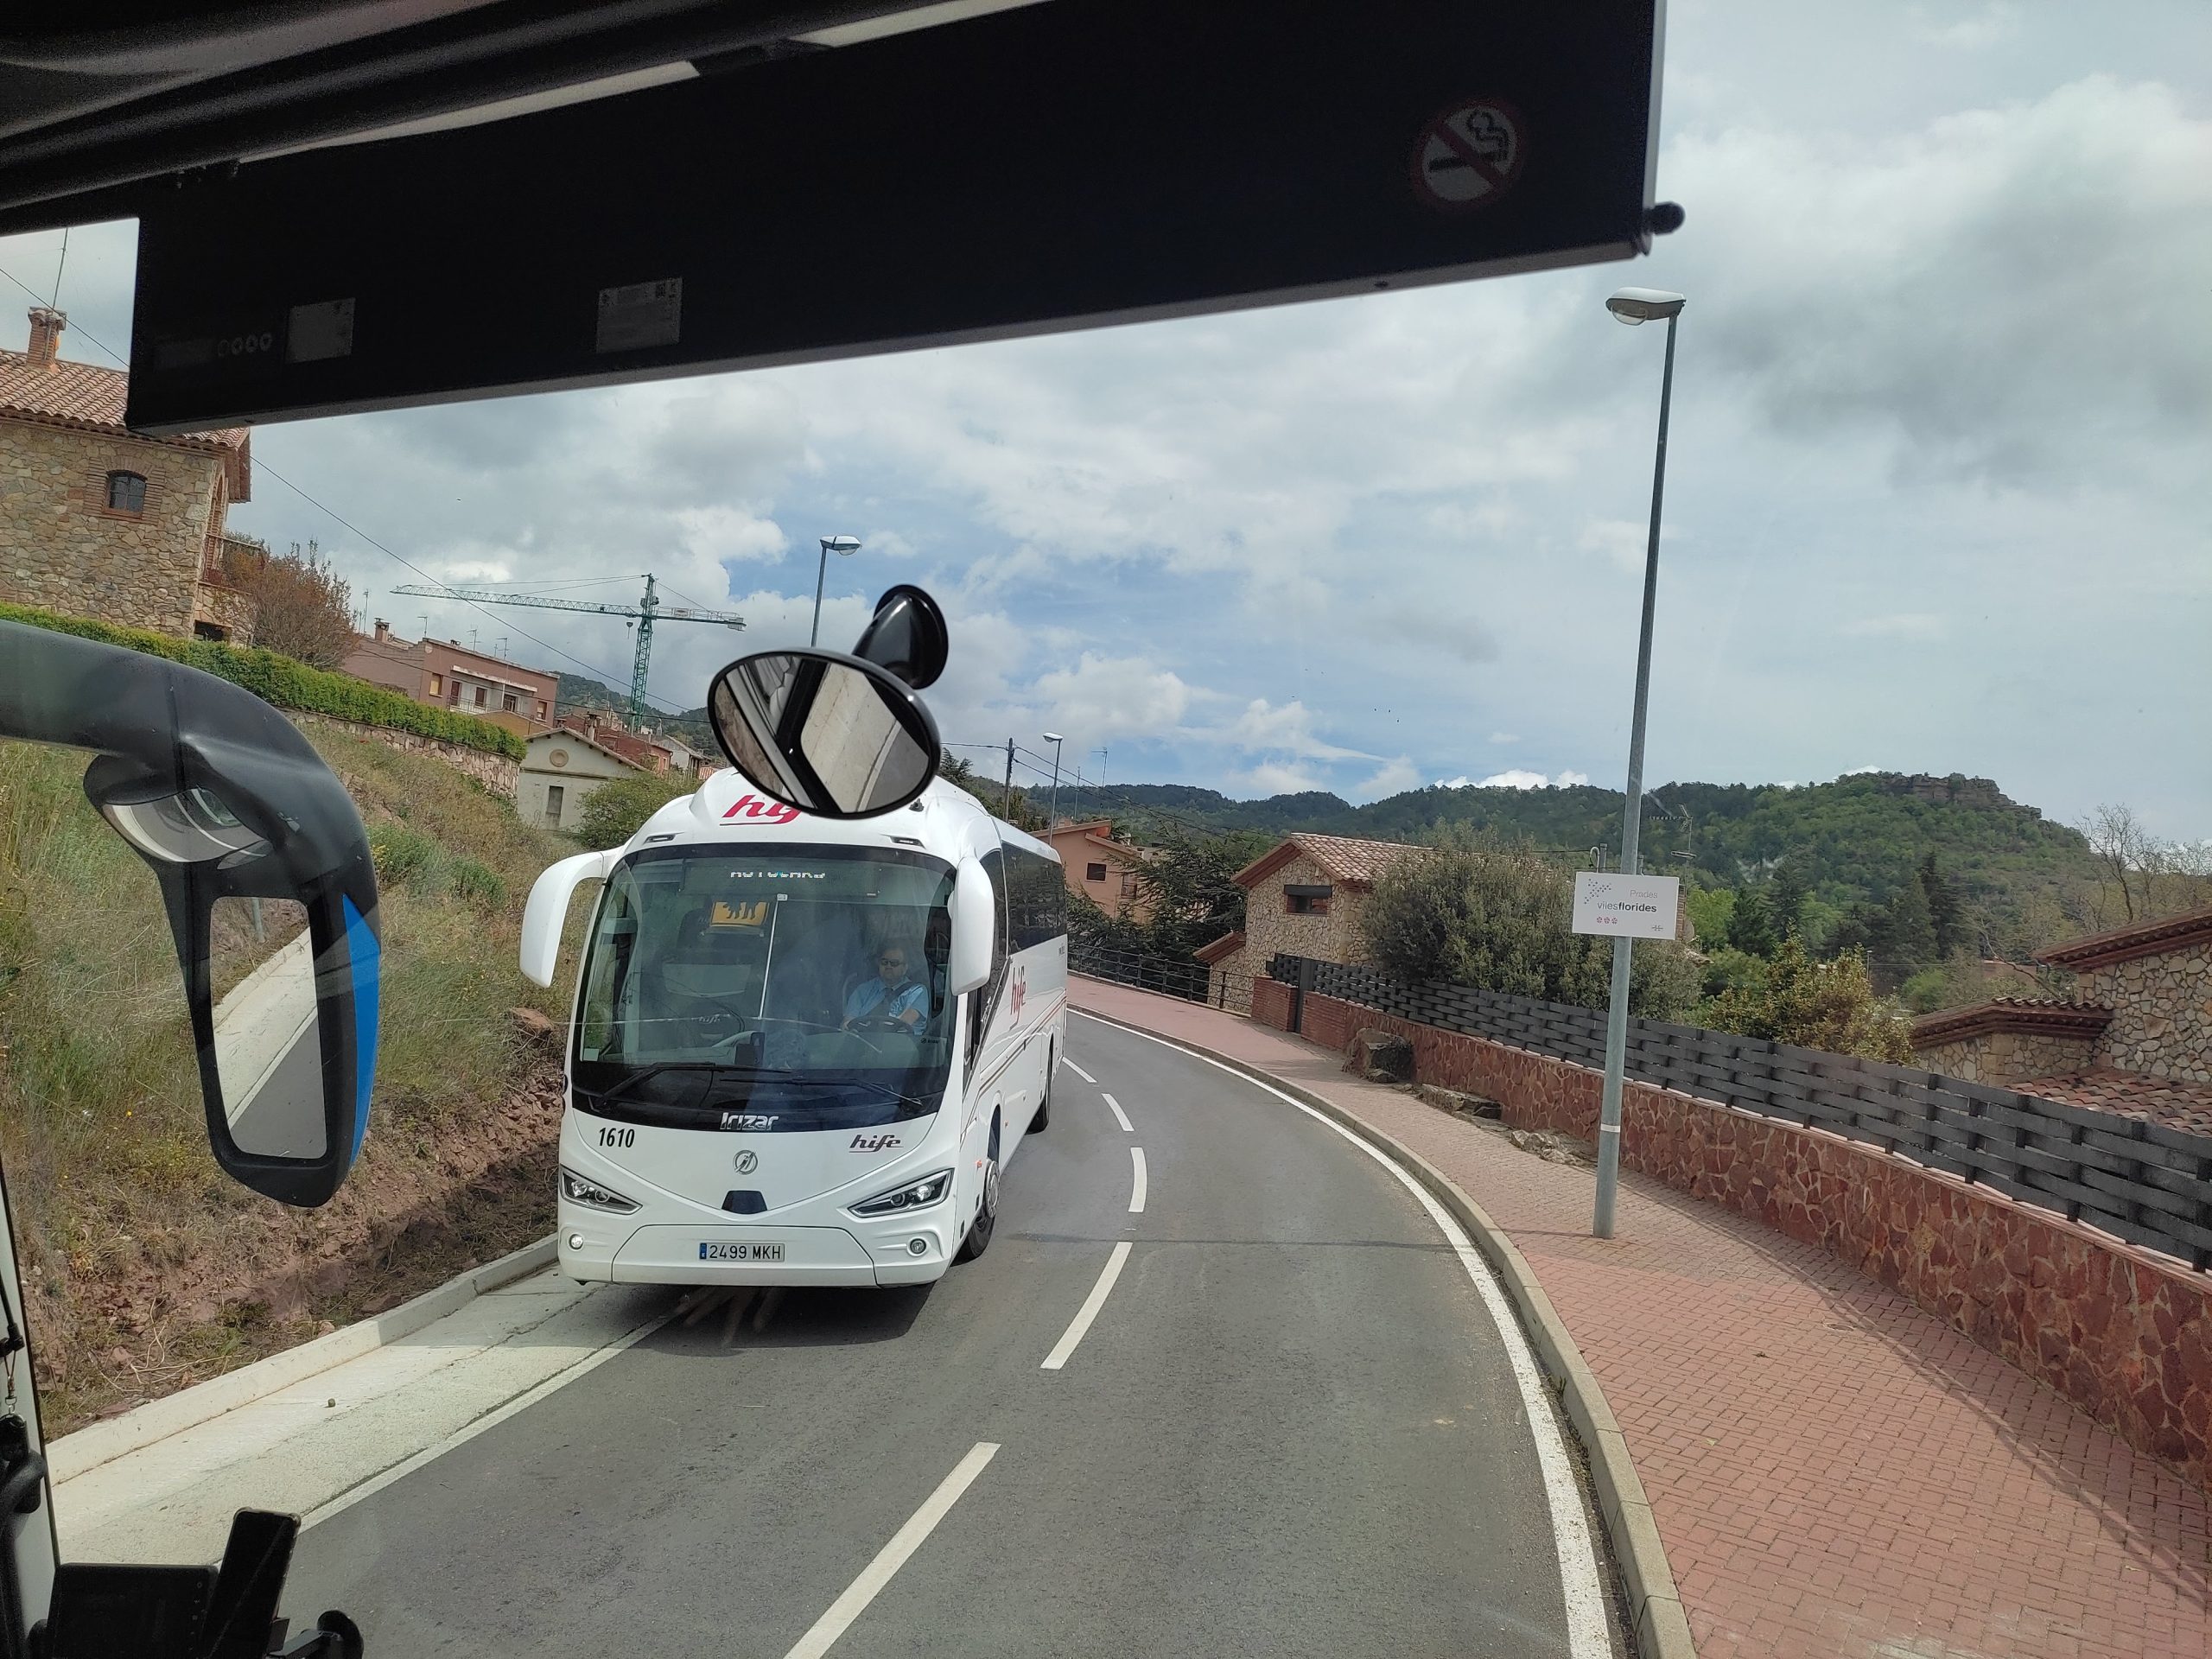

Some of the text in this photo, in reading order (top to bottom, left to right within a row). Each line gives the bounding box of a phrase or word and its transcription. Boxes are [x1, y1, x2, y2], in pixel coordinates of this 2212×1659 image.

[1630, 889, 1658, 899] Prades
[1597, 901, 1657, 912] vilesflorides
[1009, 965, 1027, 1031] hife
[598, 1127, 636, 1148] 1610
[849, 1134, 904, 1154] hife
[709, 1245, 747, 1259] 2499
[753, 1245, 781, 1259] MKH
